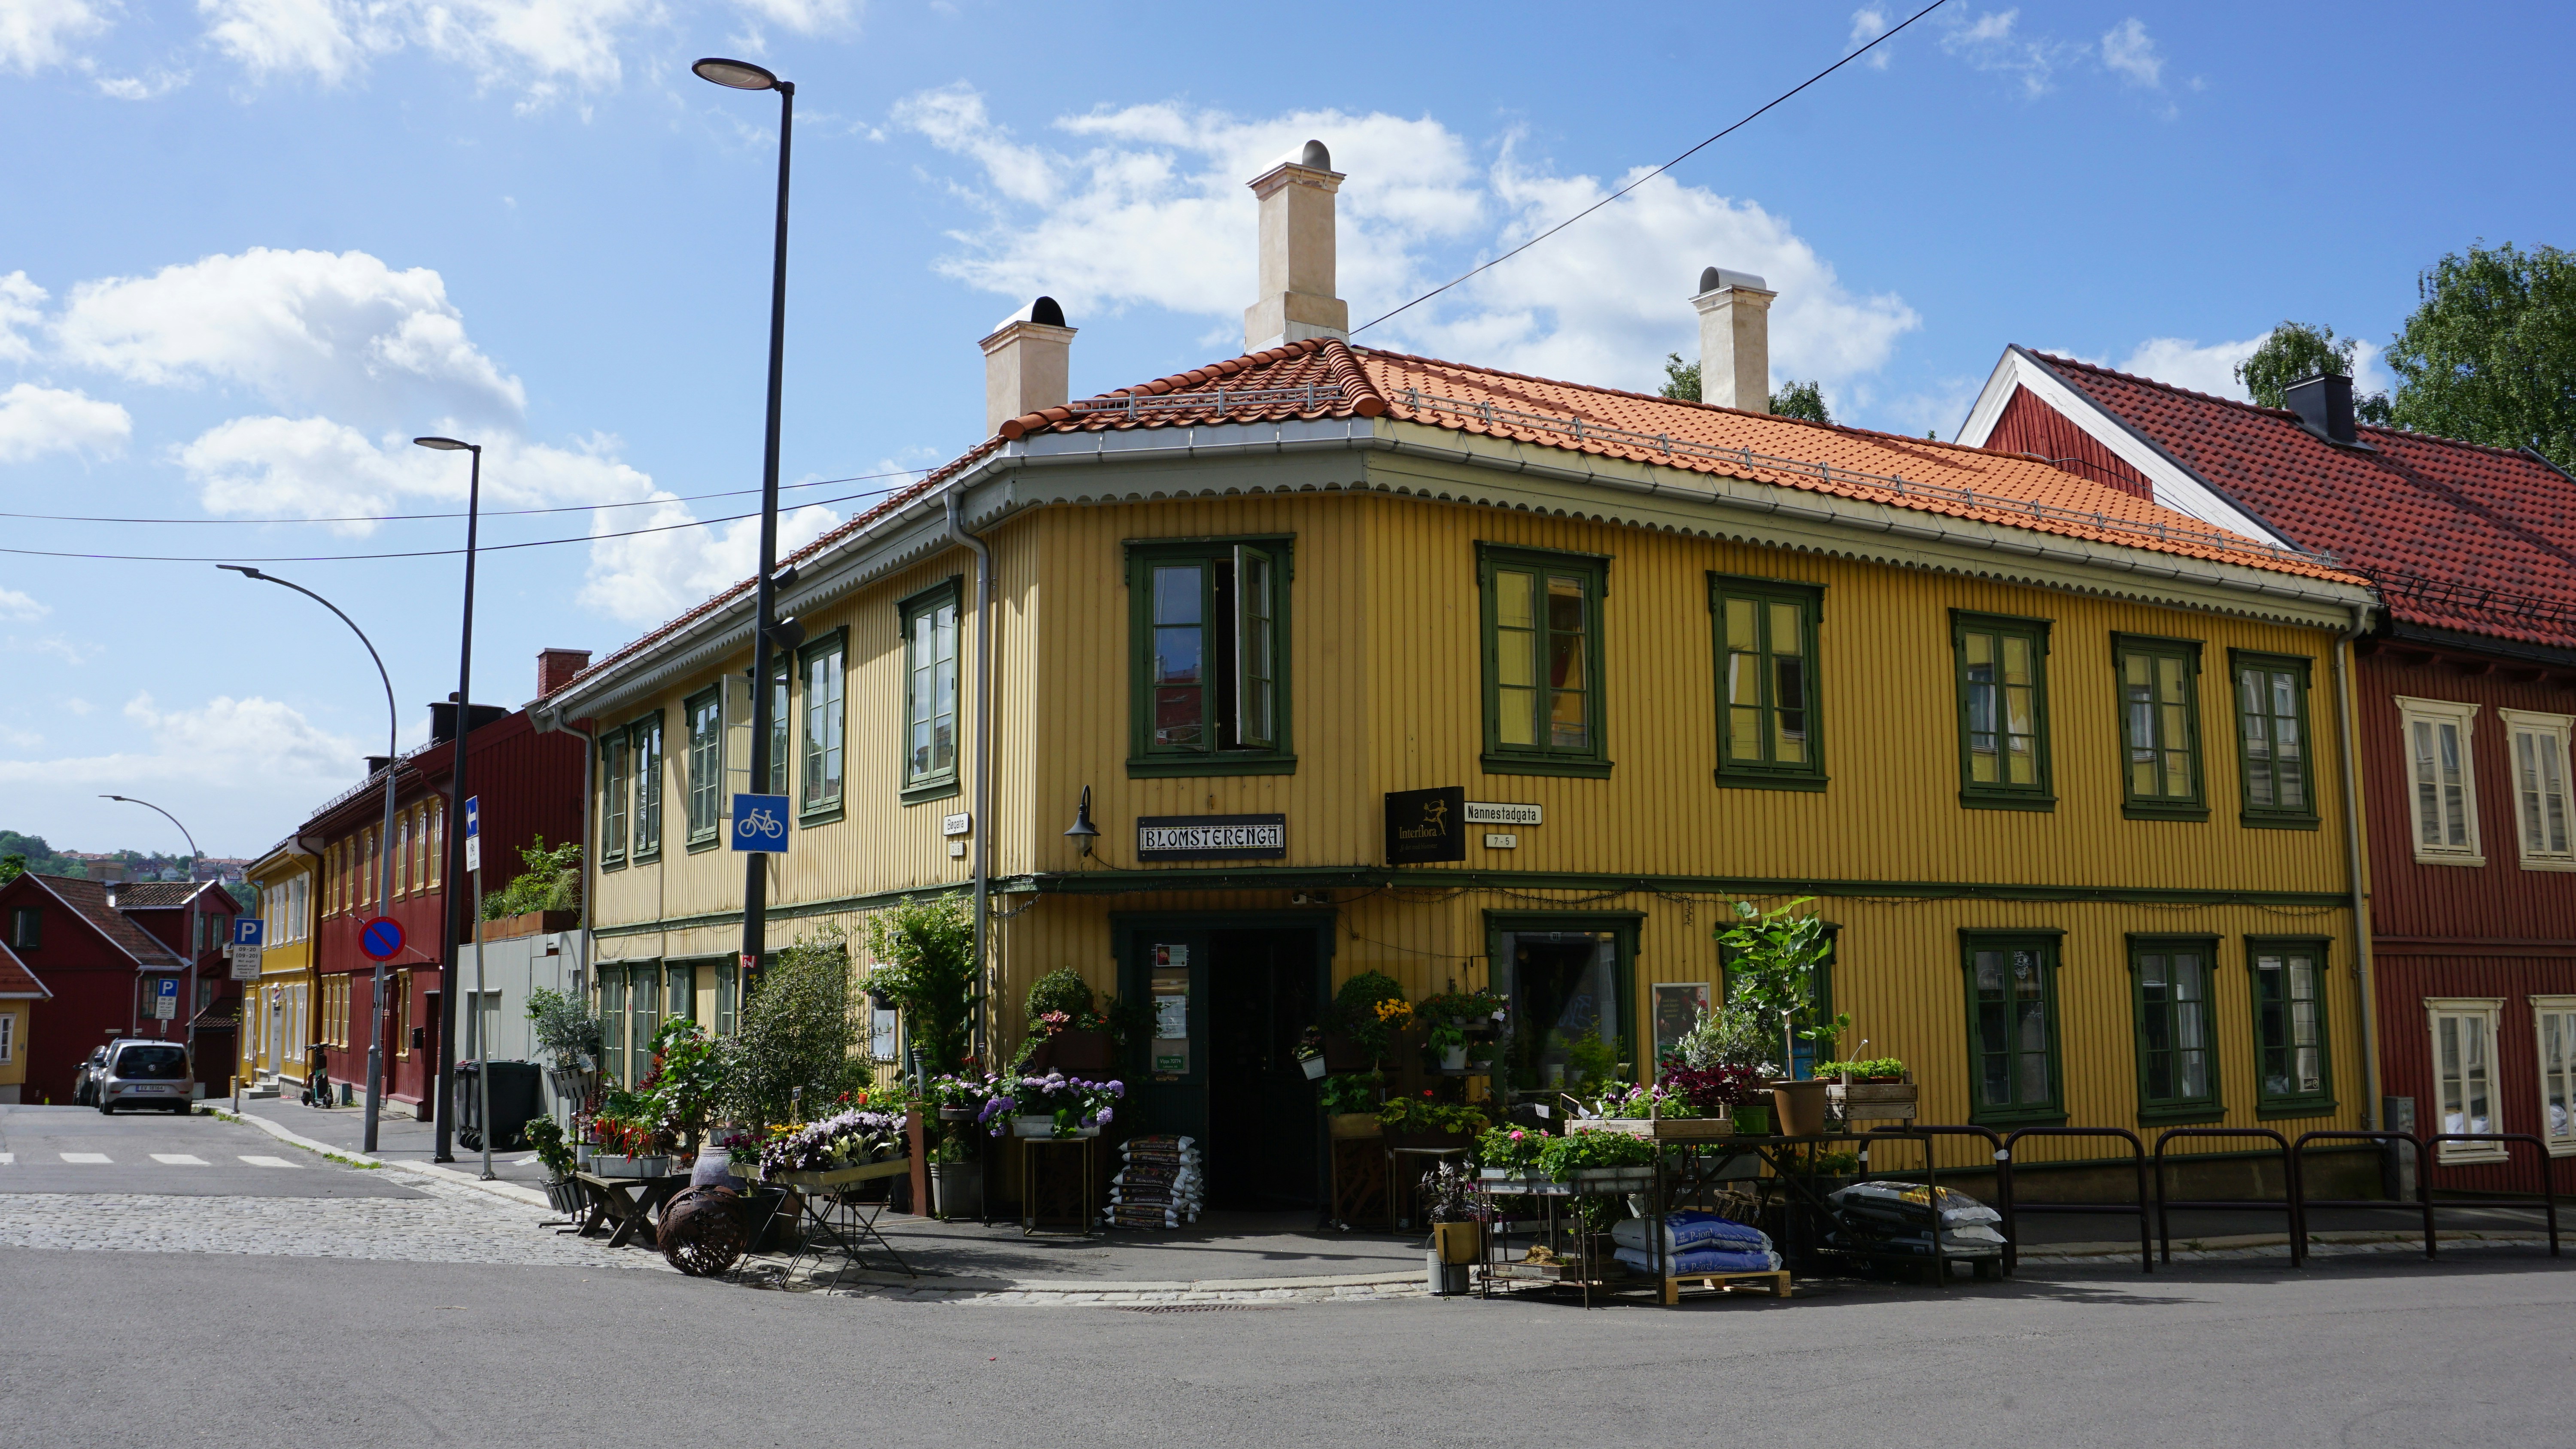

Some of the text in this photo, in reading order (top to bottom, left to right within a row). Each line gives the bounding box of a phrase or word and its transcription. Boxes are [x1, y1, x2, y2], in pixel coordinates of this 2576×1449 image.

[1468, 805, 1536, 822] Nannestadgata
[947, 817, 964, 832] Bøgata
[1399, 824, 1437, 839] Interflora
[1146, 828, 1277, 847] BLOMSTERENGA
[241, 922, 257, 941] P
[162, 981, 173, 994] P
[1690, 1228, 1713, 1241] P-jord
[1691, 1261, 1712, 1271] P-jord
